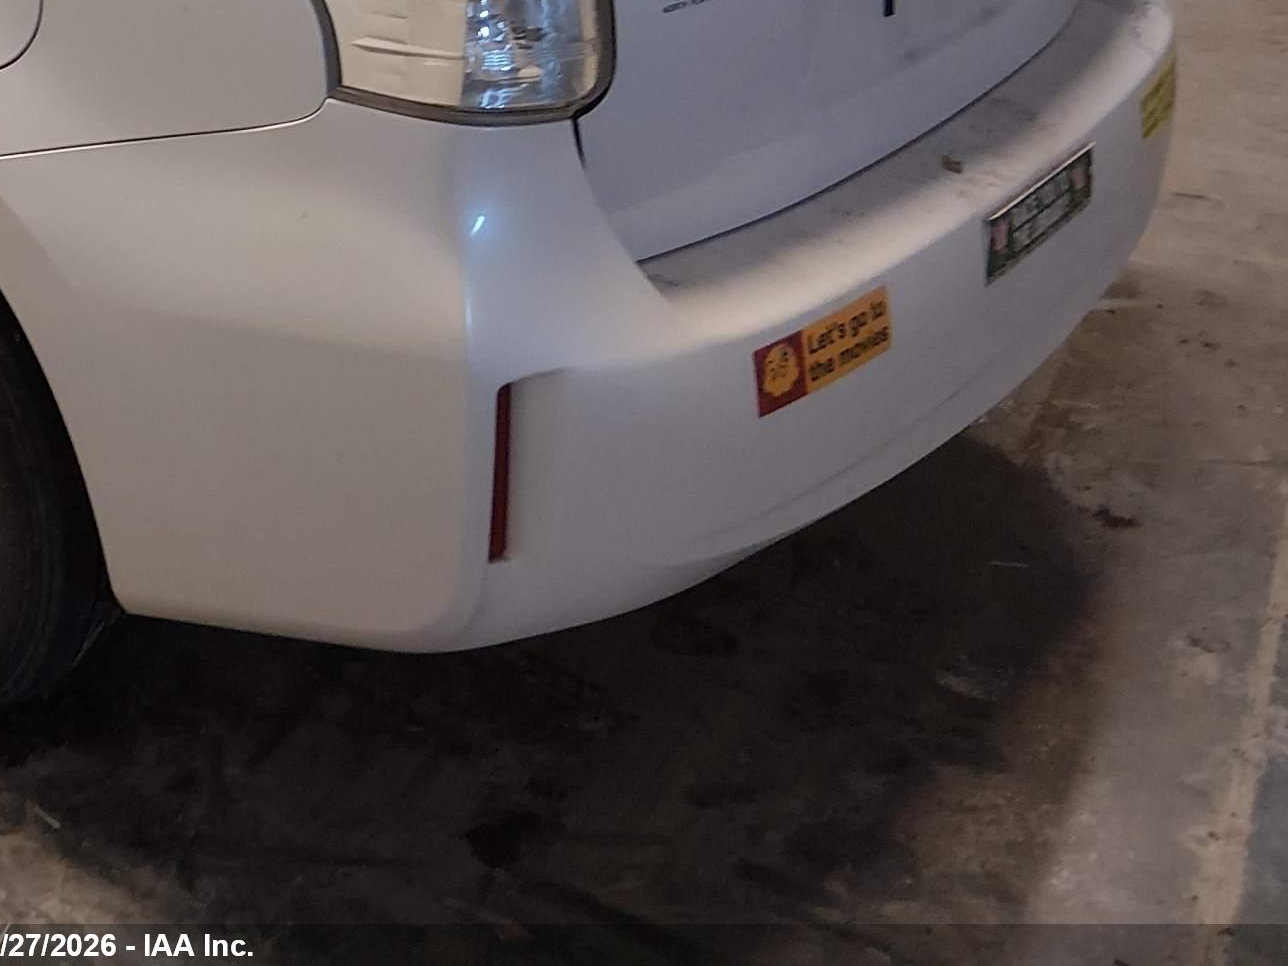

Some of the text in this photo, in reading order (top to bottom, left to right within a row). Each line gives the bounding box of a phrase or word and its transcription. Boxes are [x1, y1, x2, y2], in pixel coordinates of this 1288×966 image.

[807, 300, 885, 354] Let's go to
[808, 326, 889, 382] the movies
